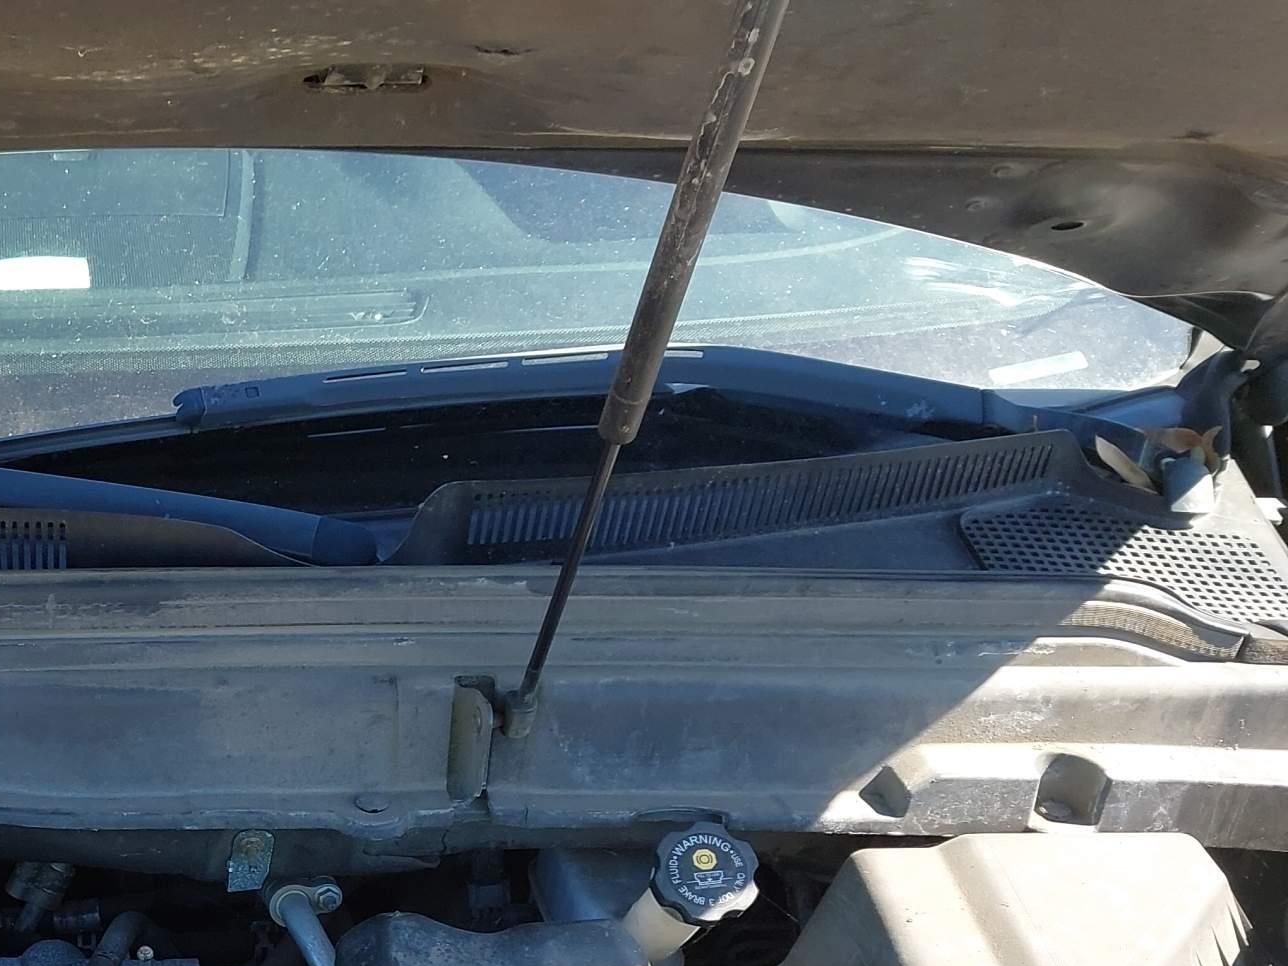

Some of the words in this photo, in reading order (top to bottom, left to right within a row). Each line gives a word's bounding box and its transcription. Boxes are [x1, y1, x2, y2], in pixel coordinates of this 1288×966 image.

[672, 834, 731, 856] WARNING
[730, 853, 744, 868] USE
[668, 859, 682, 884] FLUID
[733, 872, 746, 893] ONLY
[678, 885, 706, 906] BRAKE
[708, 898, 716, 906] 3
[718, 891, 735, 904] DOT
